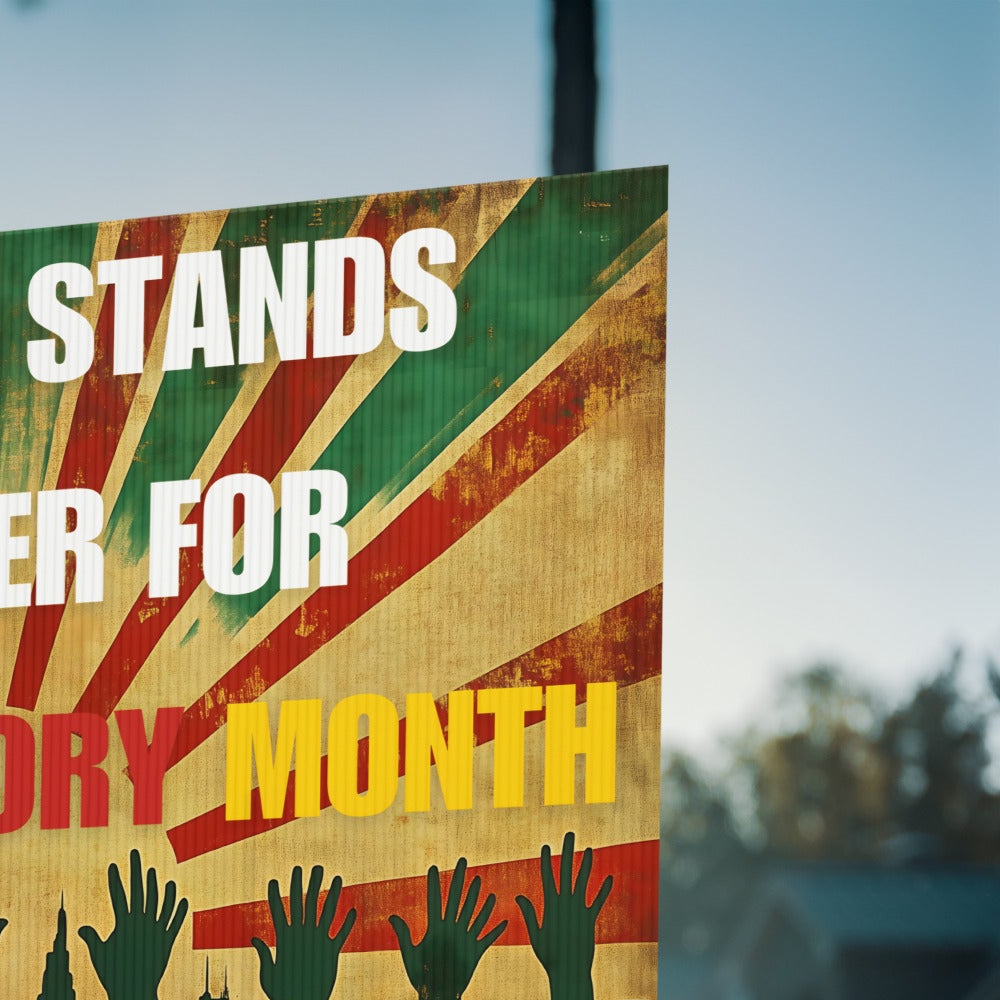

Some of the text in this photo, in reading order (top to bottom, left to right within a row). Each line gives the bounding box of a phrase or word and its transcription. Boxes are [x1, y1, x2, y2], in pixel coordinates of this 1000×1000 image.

[27, 227, 457, 384] STANDS
[149, 469, 349, 599] FOR
[225, 682, 618, 821] MONTH
